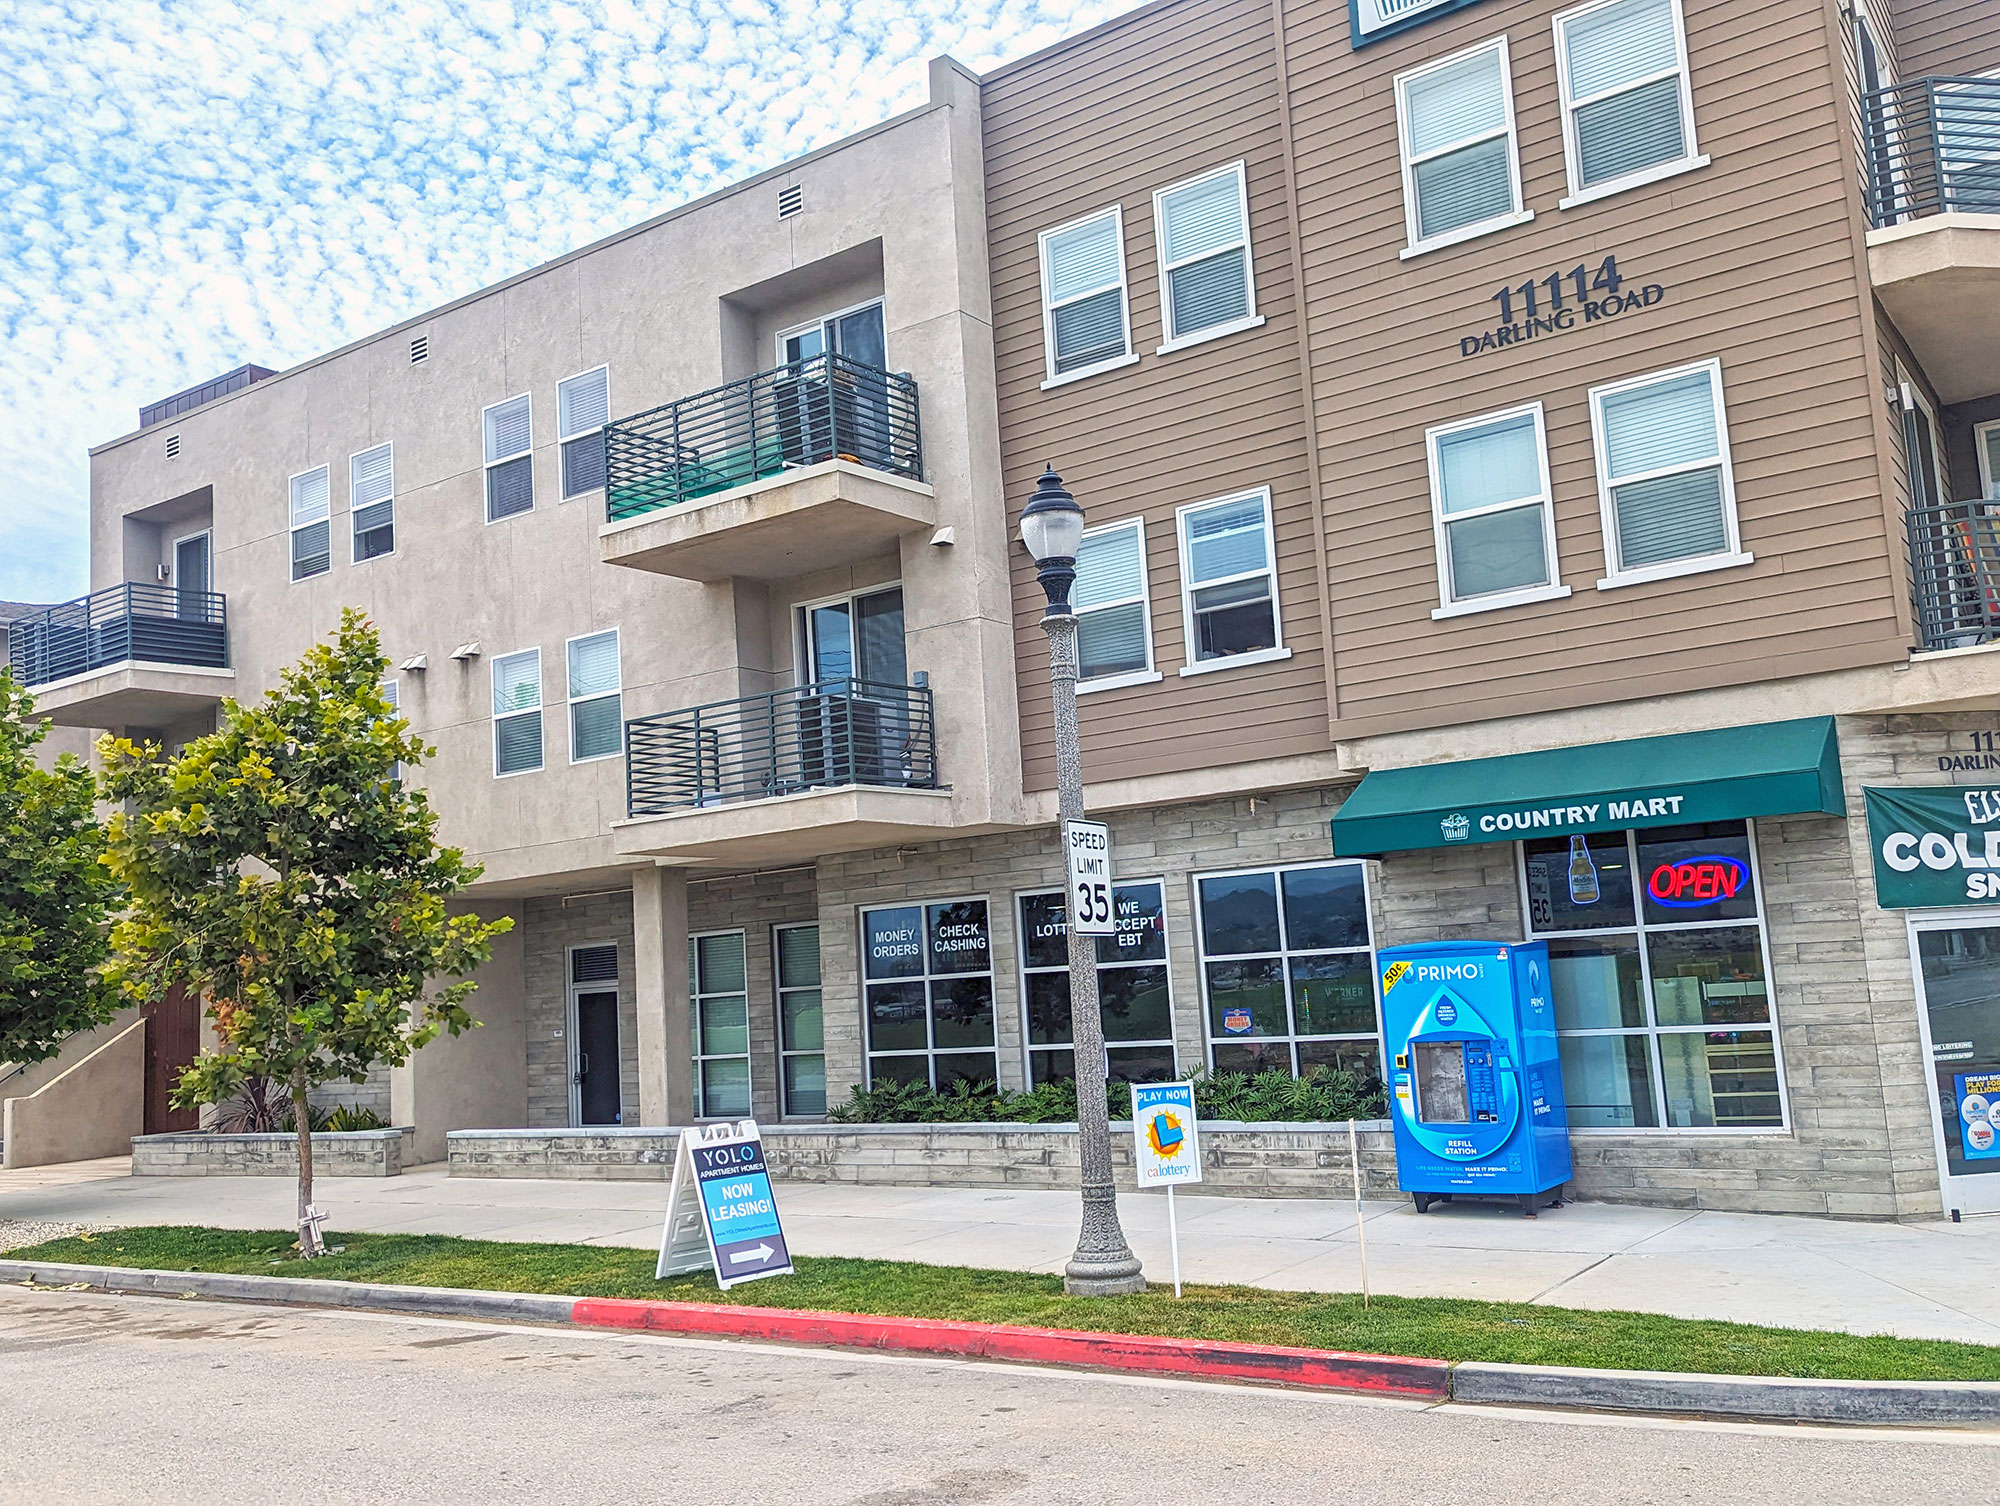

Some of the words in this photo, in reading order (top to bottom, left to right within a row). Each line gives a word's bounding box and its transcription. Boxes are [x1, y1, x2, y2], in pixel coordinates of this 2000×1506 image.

[1492, 255, 1623, 324] 11114
[1460, 308, 1575, 357] DARLING
[1584, 284, 1665, 323] ROAD
[1479, 803, 1600, 833] COUNTRY
[1608, 796, 1684, 820] MART
[1071, 831, 1106, 851] SPEED
[1076, 857, 1103, 875] LIMIT
[1648, 864, 1738, 898] OPEN
[1078, 882, 1109, 923] 35
[1118, 901, 1139, 915] WE
[939, 923, 979, 938] CHECK
[1115, 916, 1156, 931] CCEPT
[875, 929, 915, 943] MONEY
[1118, 933, 1143, 947] EBT
[873, 943, 919, 958] ORDERS
[934, 938, 986, 952] CASHING
[1418, 963, 1478, 982] PRIMO
[1530, 997, 1545, 1007] PRIMO
[1137, 1091, 1163, 1102] PLAY
[1166, 1089, 1188, 1101] NOW
[702, 1146, 754, 1166] YOLO
[700, 1166, 740, 1179] APARTMENT
[741, 1163, 764, 1173] HOMES
[1147, 1163, 1190, 1177] calottery
[721, 1183, 753, 1200] NOW
[711, 1199, 772, 1222] LEASING!
